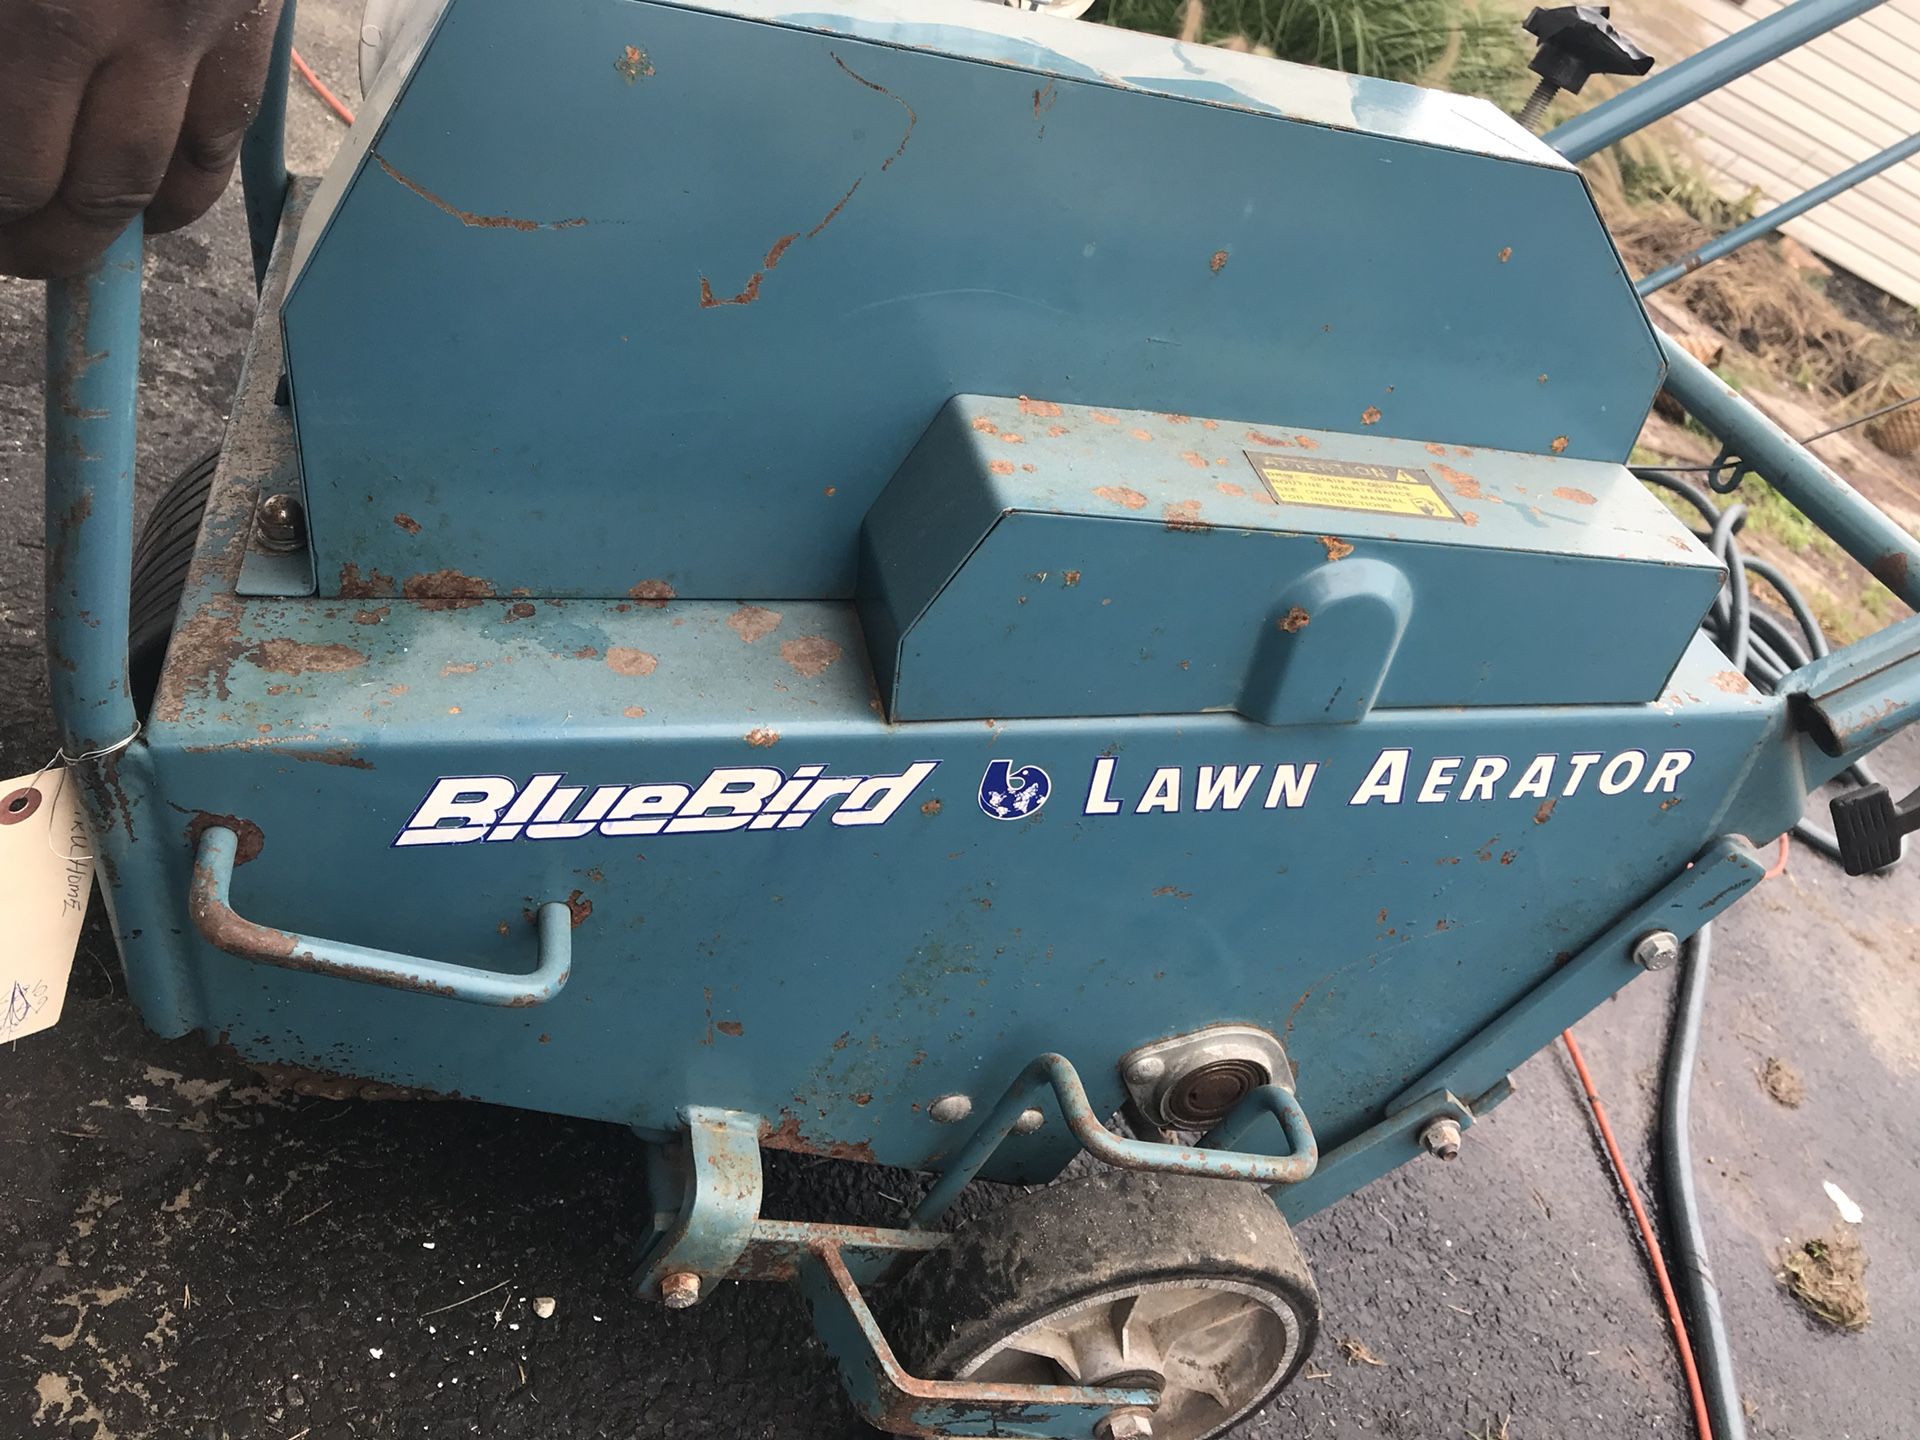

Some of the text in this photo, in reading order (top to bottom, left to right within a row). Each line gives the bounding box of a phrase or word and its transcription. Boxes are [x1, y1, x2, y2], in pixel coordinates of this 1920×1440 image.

[1263, 456, 1389, 479] ATTENTION
[1271, 479, 1412, 497] ROUTINE MAINTENANCE
[1309, 475, 1345, 484] CHAIN
[1351, 480, 1411, 491] REQUIRES
[1310, 497, 1393, 510] INSTRUCTIONS
[1359, 494, 1408, 505] MANUAL
[1083, 747, 1695, 816] LAWN AERATOR
[391, 759, 943, 848] BlueBird
